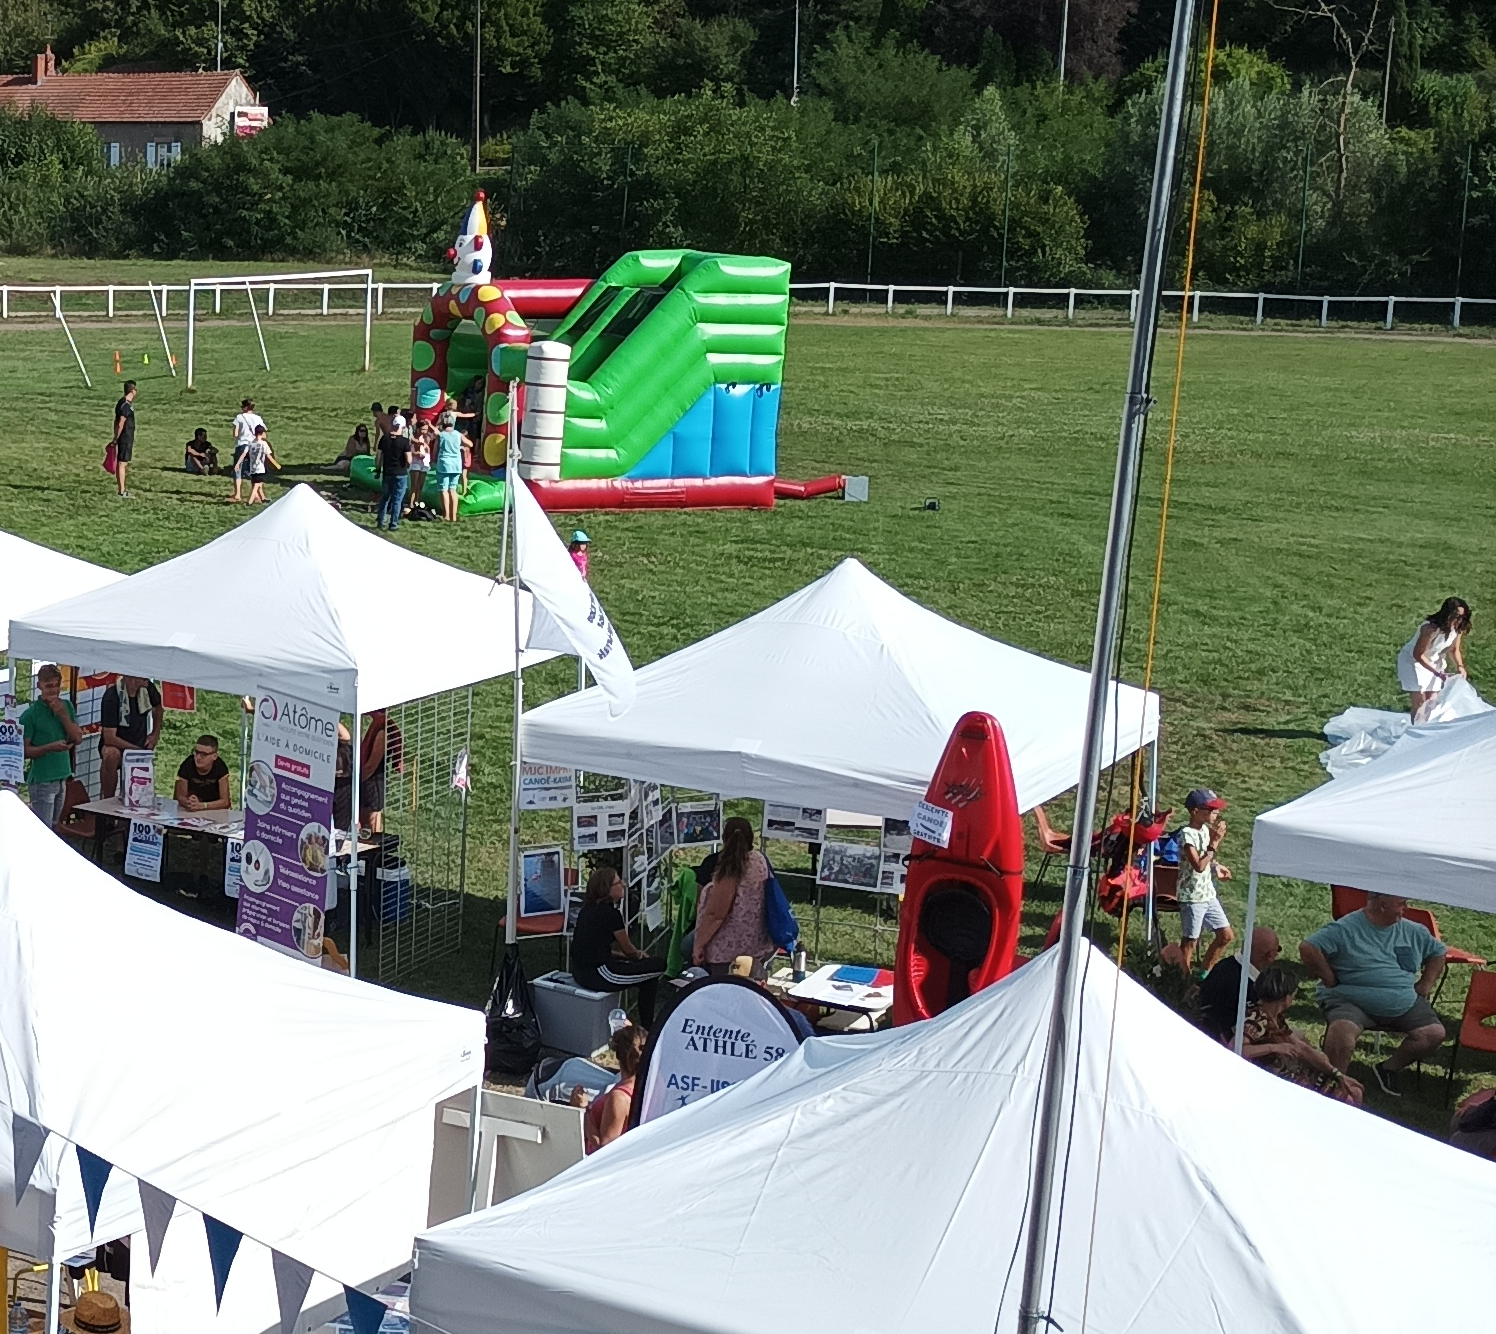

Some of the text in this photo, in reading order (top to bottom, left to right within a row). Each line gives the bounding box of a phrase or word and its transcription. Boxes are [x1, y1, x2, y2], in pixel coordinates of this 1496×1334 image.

[279, 701, 335, 737] Atôme
[257, 732, 281, 748] L'AIDE
[293, 744, 331, 764] DOMICILE
[522, 765, 543, 776] MJC
[281, 782, 329, 805] Accompagnement
[287, 806, 312, 819] quotidien
[133, 822, 151, 835] 100
[680, 1018, 752, 1043] Entente
[684, 1035, 786, 1062] ATHLÉ 58
